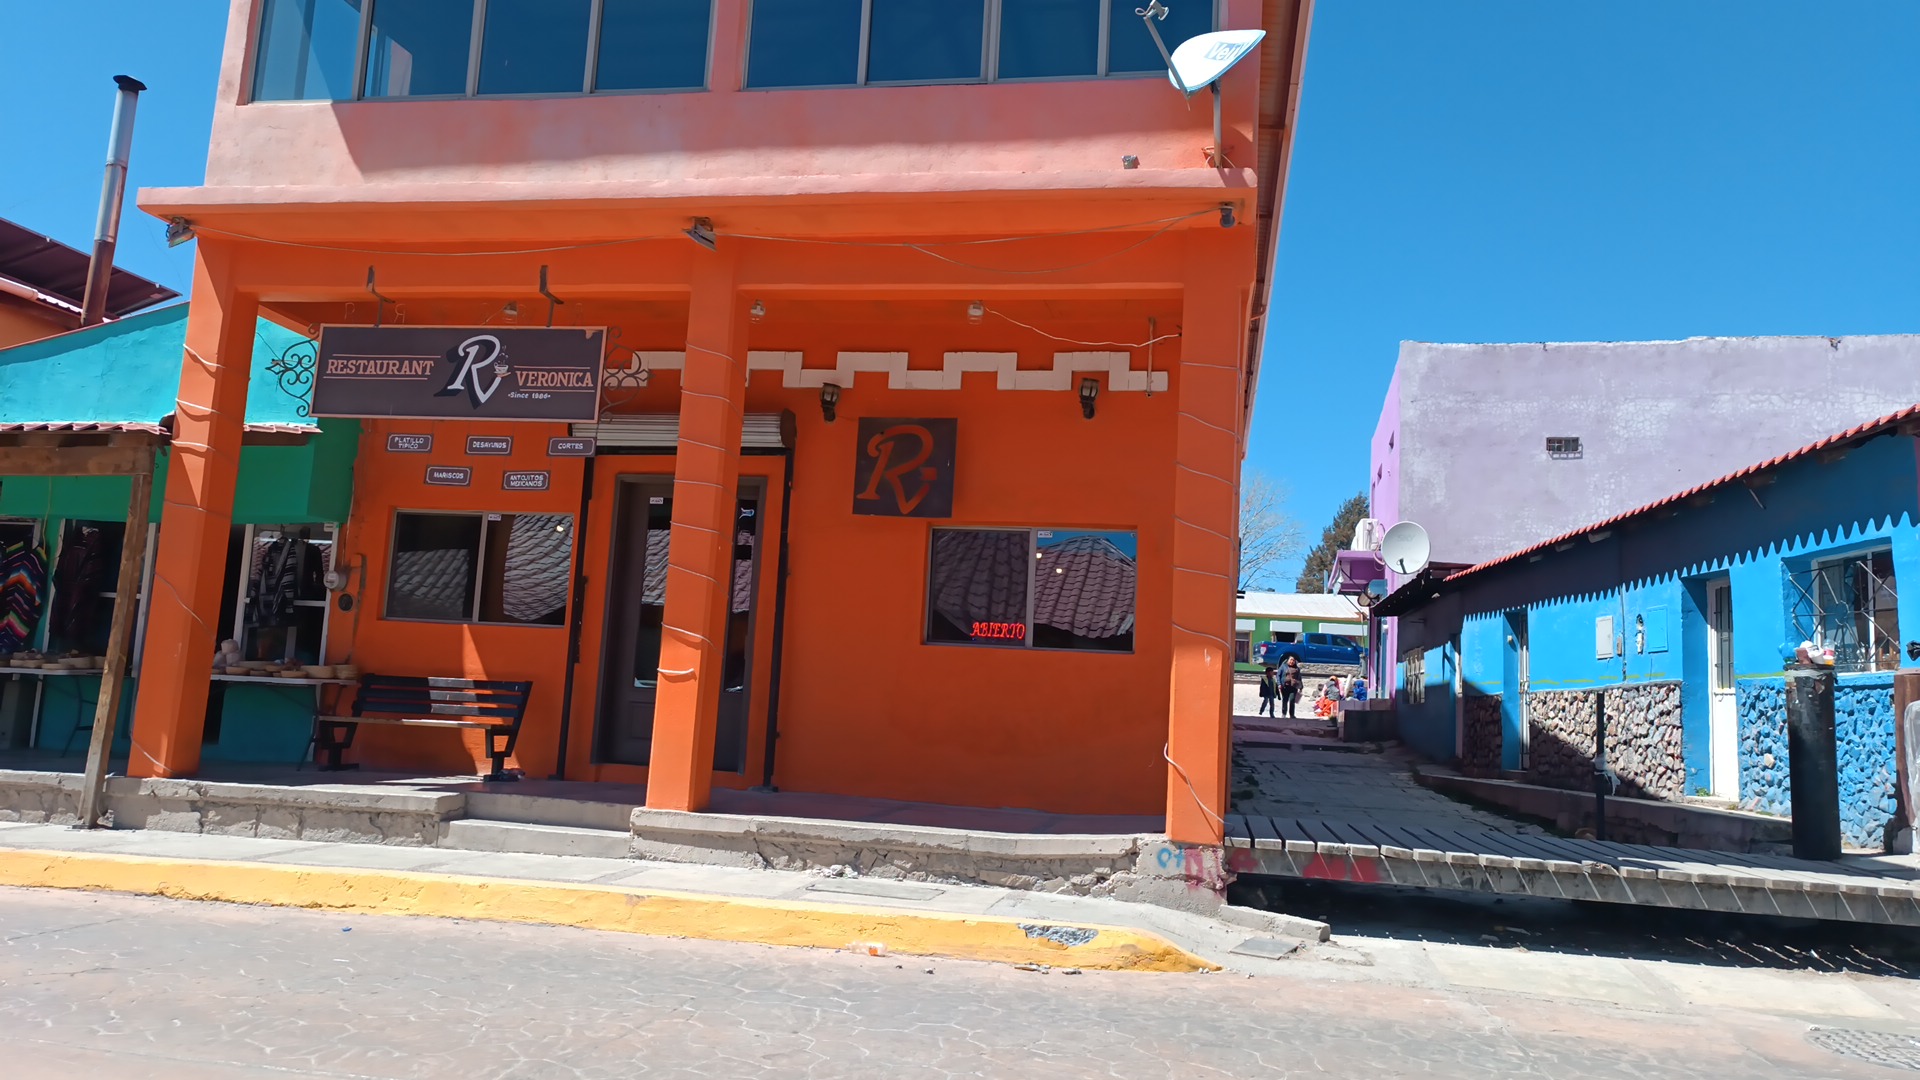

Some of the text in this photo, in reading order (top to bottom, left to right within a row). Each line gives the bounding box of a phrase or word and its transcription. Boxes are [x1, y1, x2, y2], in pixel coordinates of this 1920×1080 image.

[326, 359, 435, 377] RESTAURANT
[515, 370, 594, 388] VERONICA
[510, 391, 529, 399] Since
[394, 436, 425, 444] PLATILLO
[472, 440, 507, 449] DESAYUNOS
[557, 442, 584, 450] CORTES
[433, 471, 464, 480] MARISCOS
[969, 621, 1026, 640] ABIERTO
